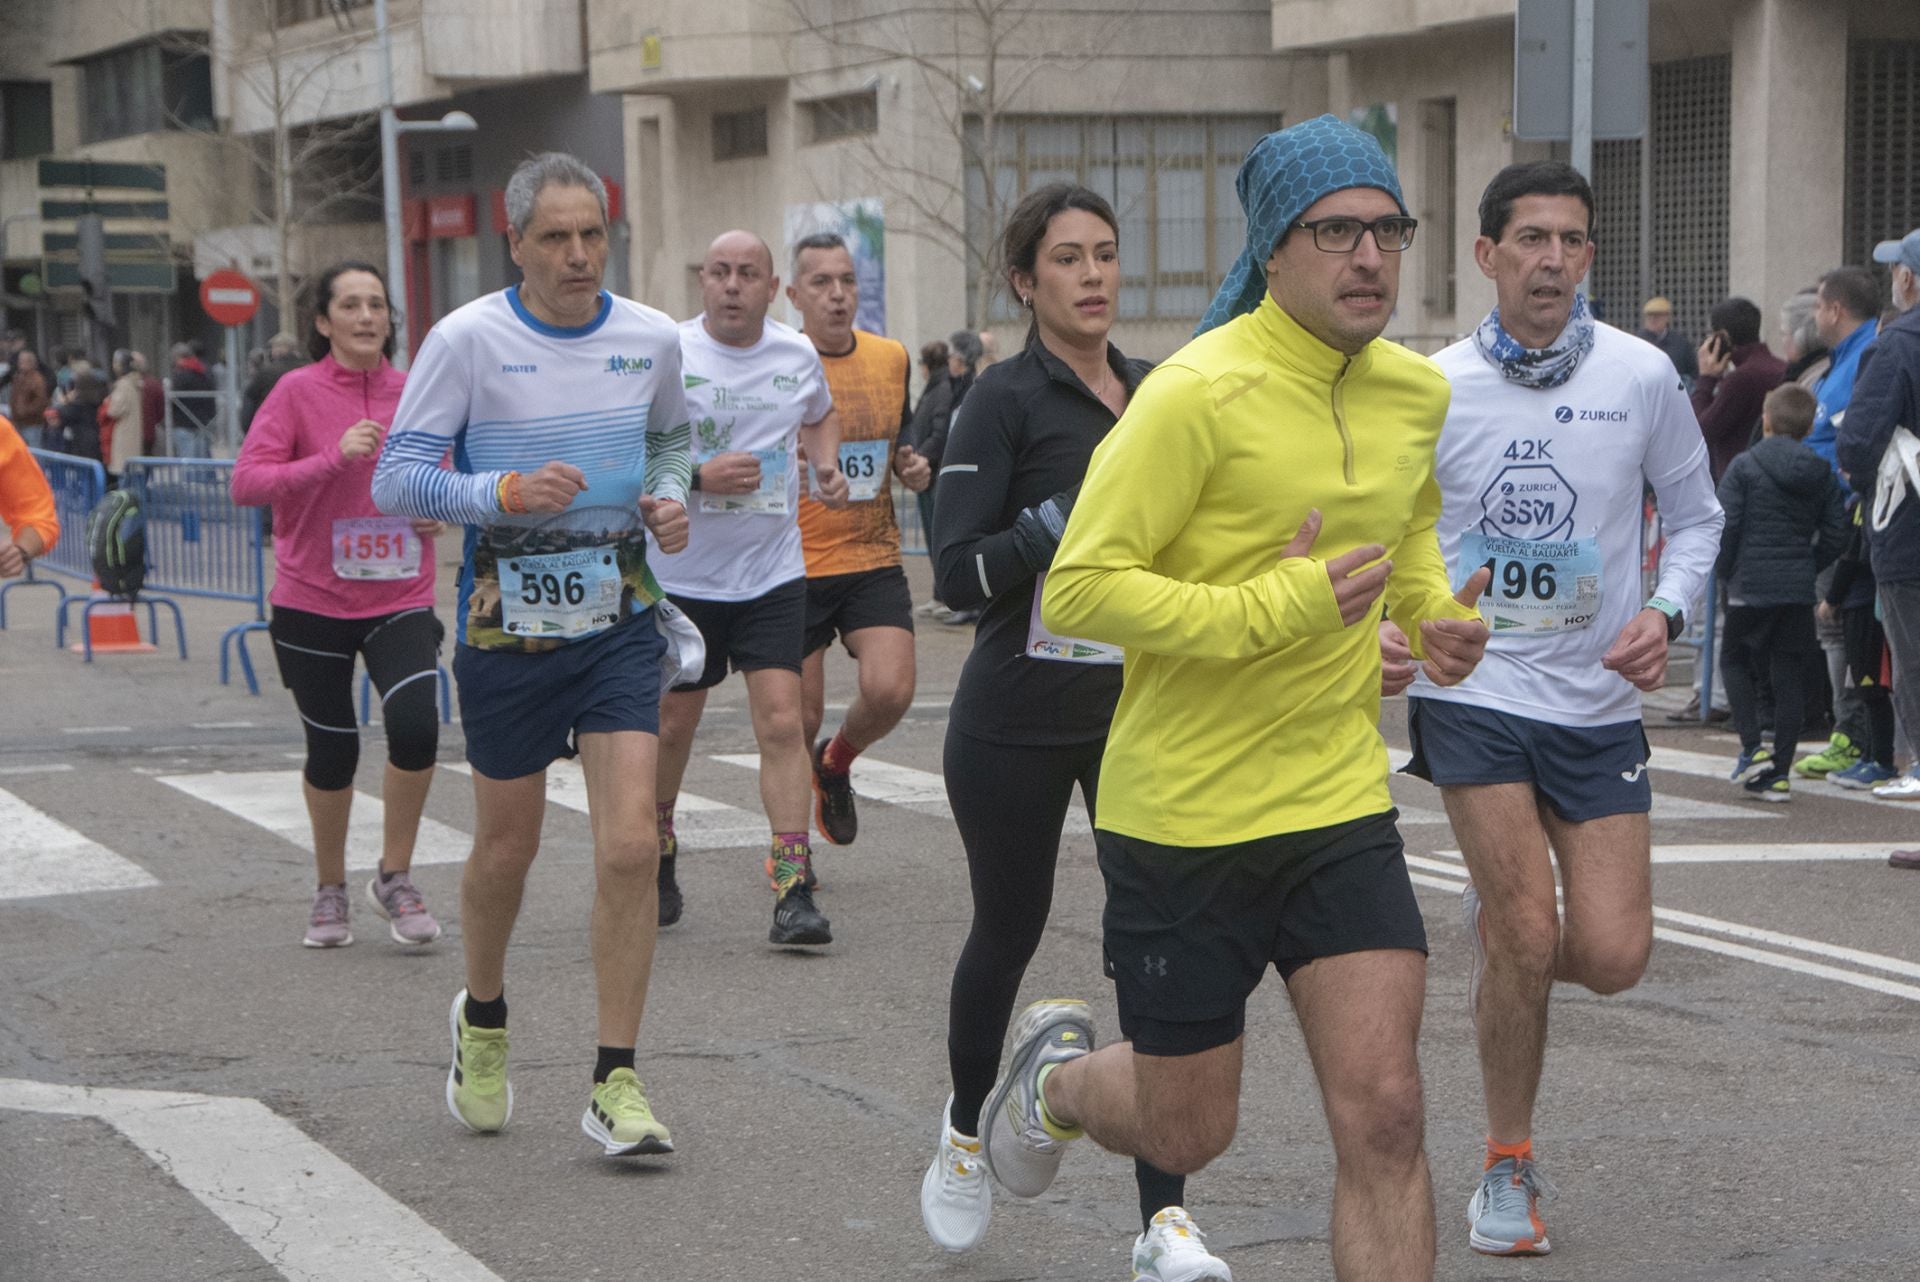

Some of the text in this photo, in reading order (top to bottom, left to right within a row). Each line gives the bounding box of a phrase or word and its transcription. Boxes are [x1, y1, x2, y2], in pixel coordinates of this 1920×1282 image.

[502, 364, 537, 373] FASTER
[1579, 410, 1628, 422] ZURICH
[1503, 439, 1554, 461] 42K
[837, 454, 875, 479] 63
[1519, 484, 1557, 492] ZURICH
[340, 532, 404, 560] 1551
[1486, 543, 1516, 555] VUELTA
[1519, 548, 1529, 558] AL
[1532, 549, 1580, 559] BALUARTE
[1480, 557, 1557, 600] 196
[520, 571, 585, 606] 596
[1564, 613, 1594, 626] HOY
